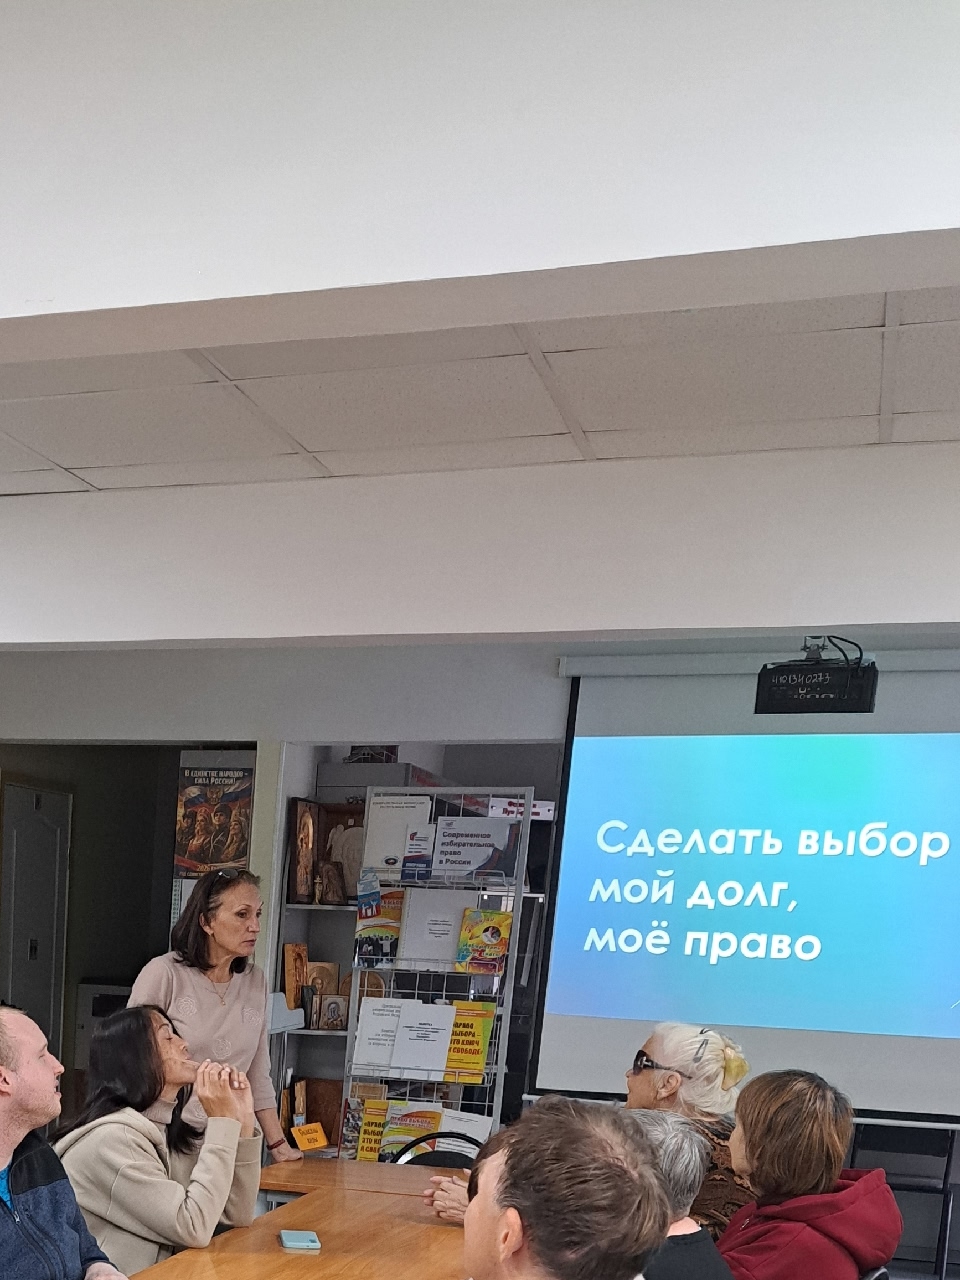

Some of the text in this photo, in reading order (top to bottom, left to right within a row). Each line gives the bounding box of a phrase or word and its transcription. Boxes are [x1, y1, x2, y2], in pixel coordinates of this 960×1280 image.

[441, 840, 495, 848] избирательное
[442, 831, 492, 839] Современное
[596, 820, 950, 866] Сделать выбор
[445, 858, 472, 866] России
[588, 869, 798, 912] мой долг,
[583, 920, 823, 965] моё право
